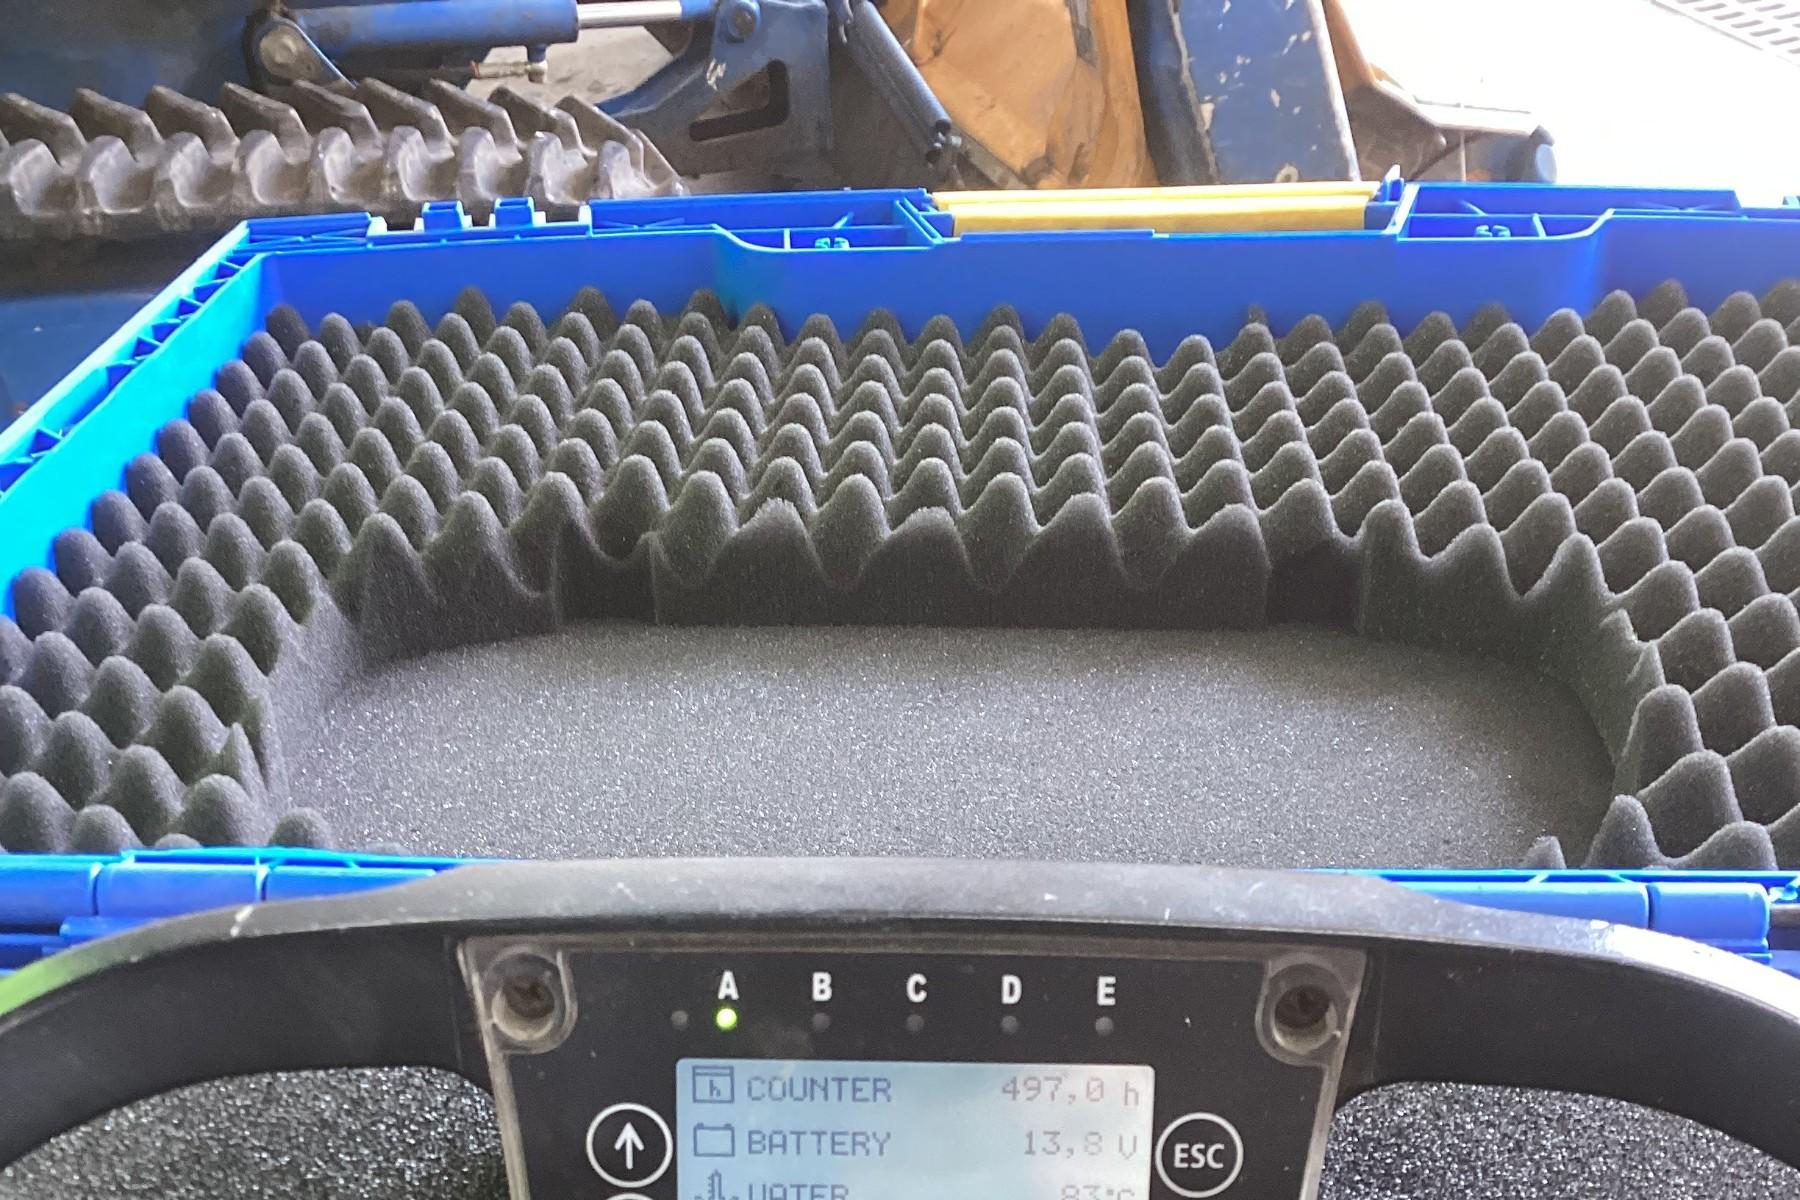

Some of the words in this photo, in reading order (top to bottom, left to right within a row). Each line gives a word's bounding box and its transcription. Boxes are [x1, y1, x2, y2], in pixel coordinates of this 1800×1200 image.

[718, 971, 739, 1000] A
[812, 972, 832, 1002] B
[906, 974, 928, 1003] C
[1002, 975, 1022, 1004] D
[1097, 976, 1116, 1006] E
[747, 1076, 892, 1102] COUNTER
[1002, 1076, 1104, 1104] 497,0
[1123, 1081, 1140, 1106] h
[748, 1130, 891, 1156] BATTERY
[1024, 1131, 1103, 1158] 13,8
[1118, 1135, 1137, 1160] V
[1173, 1142, 1225, 1171] ESC
